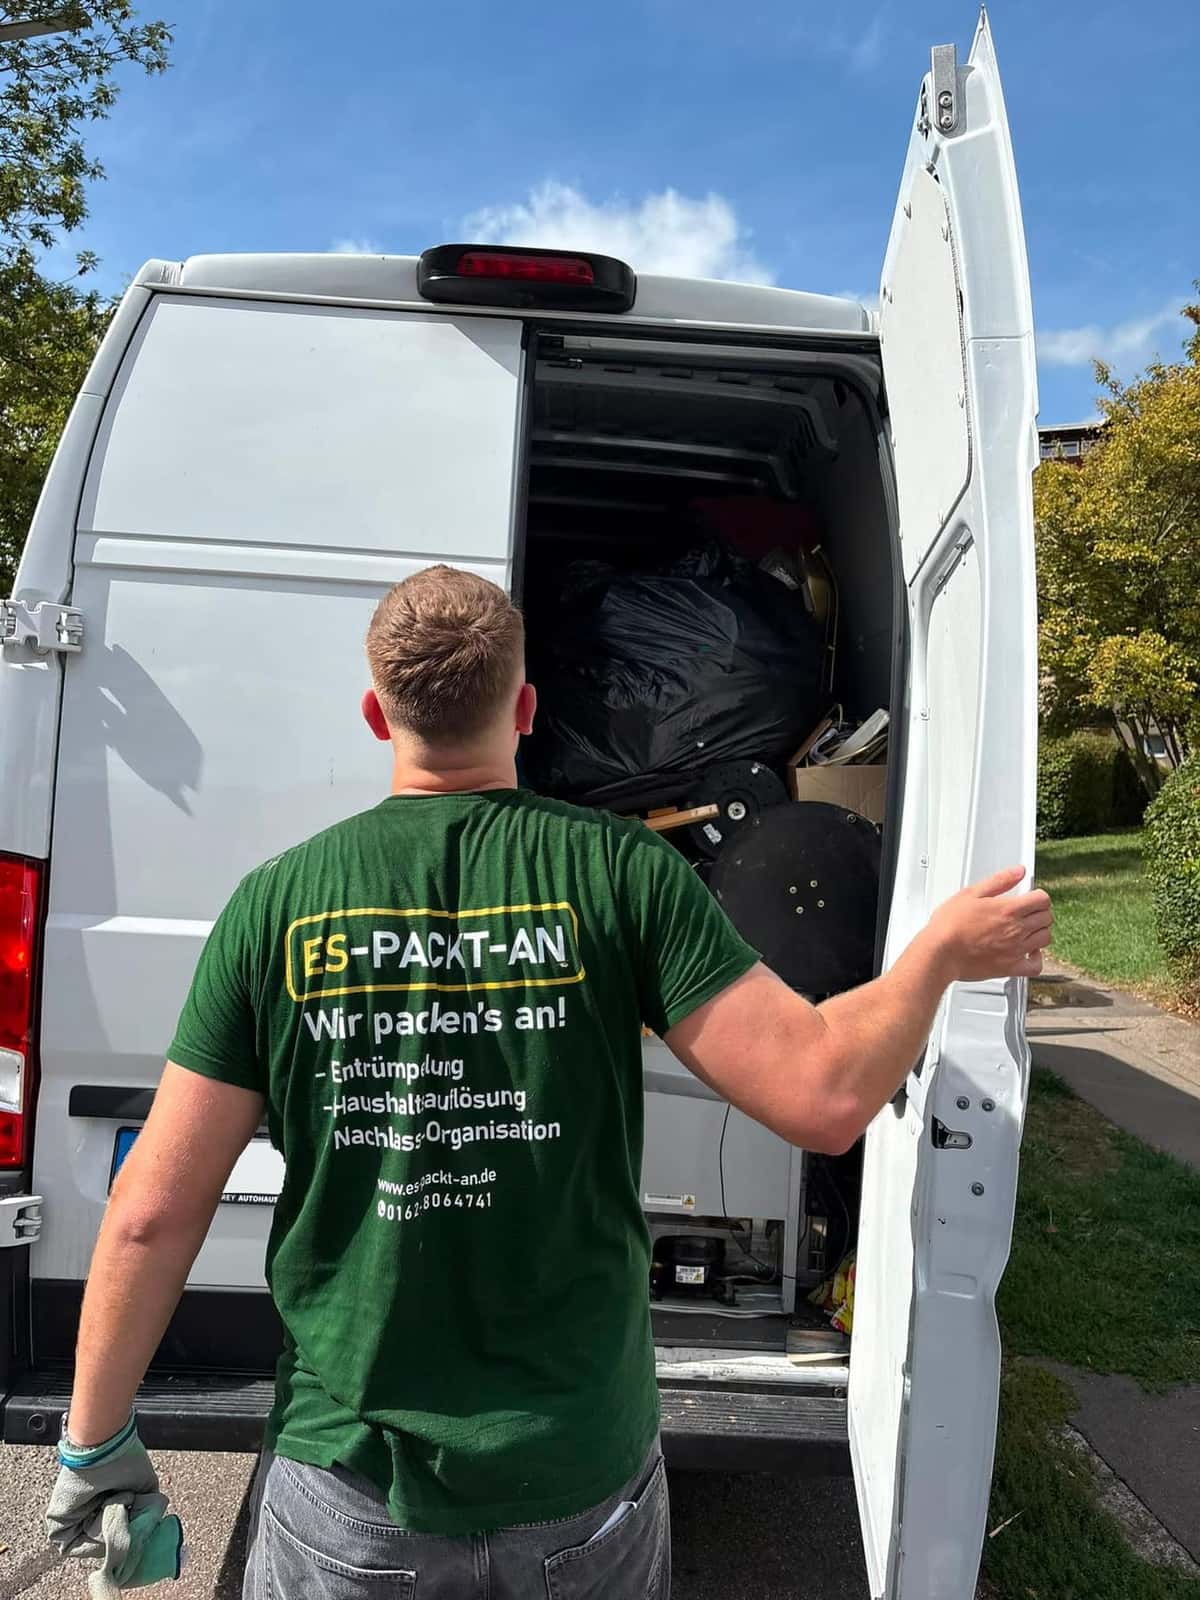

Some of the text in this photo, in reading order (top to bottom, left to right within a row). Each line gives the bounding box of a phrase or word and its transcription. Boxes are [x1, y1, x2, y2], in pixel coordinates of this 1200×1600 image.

[303, 925, 566, 977] ES-PACKT-AN
[304, 996, 566, 1045] Wir packen's an!
